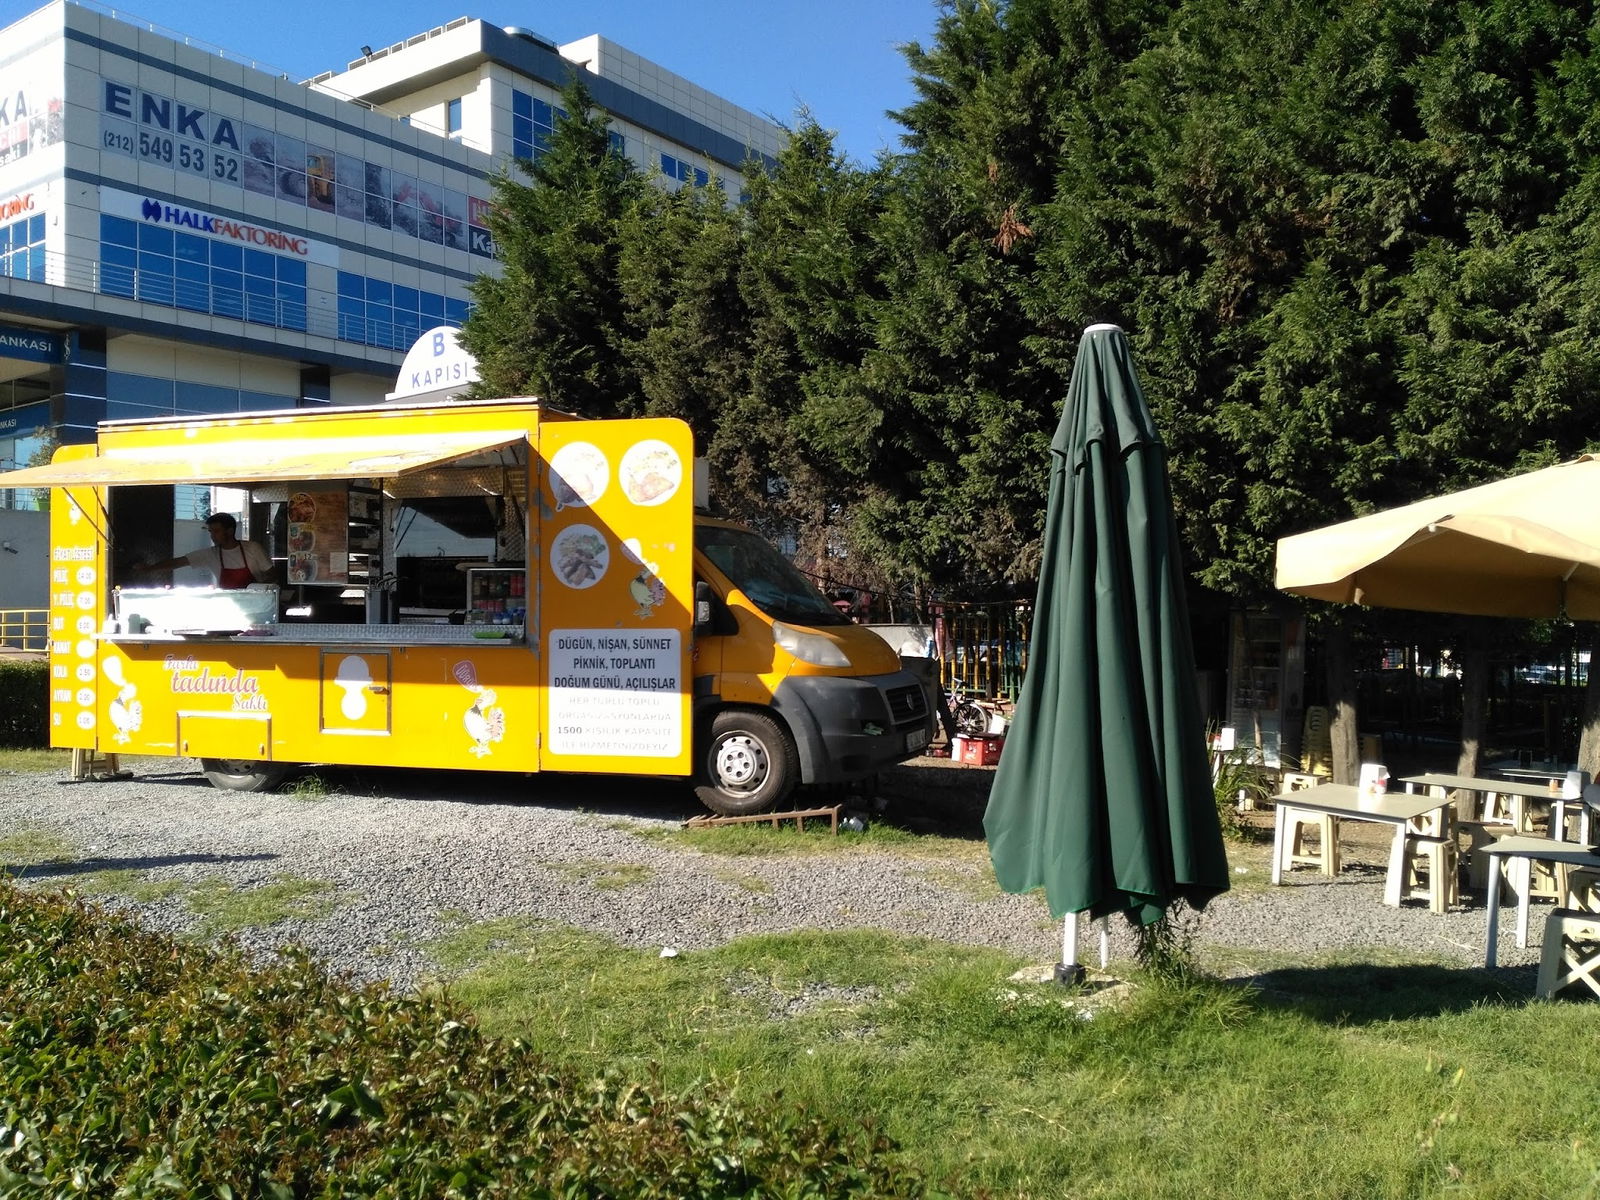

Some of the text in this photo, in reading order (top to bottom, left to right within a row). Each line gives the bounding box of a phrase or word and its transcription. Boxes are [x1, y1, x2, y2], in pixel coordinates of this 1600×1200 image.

[105, 81, 240, 151] ENKA
[103, 129, 238, 182] (212) 549 53 52
[432, 332, 445, 357] B
[411, 362, 468, 389] KAPISI
[598, 636, 631, 653] NİŞAN,
[632, 636, 671, 650] SÜNNET
[573, 655, 656, 671] PİKNİK, TOPLANTI
[554, 674, 590, 688] DOĞUM
[625, 677, 676, 692] AÇILIŞLAR
[558, 726, 582, 735] 1500
